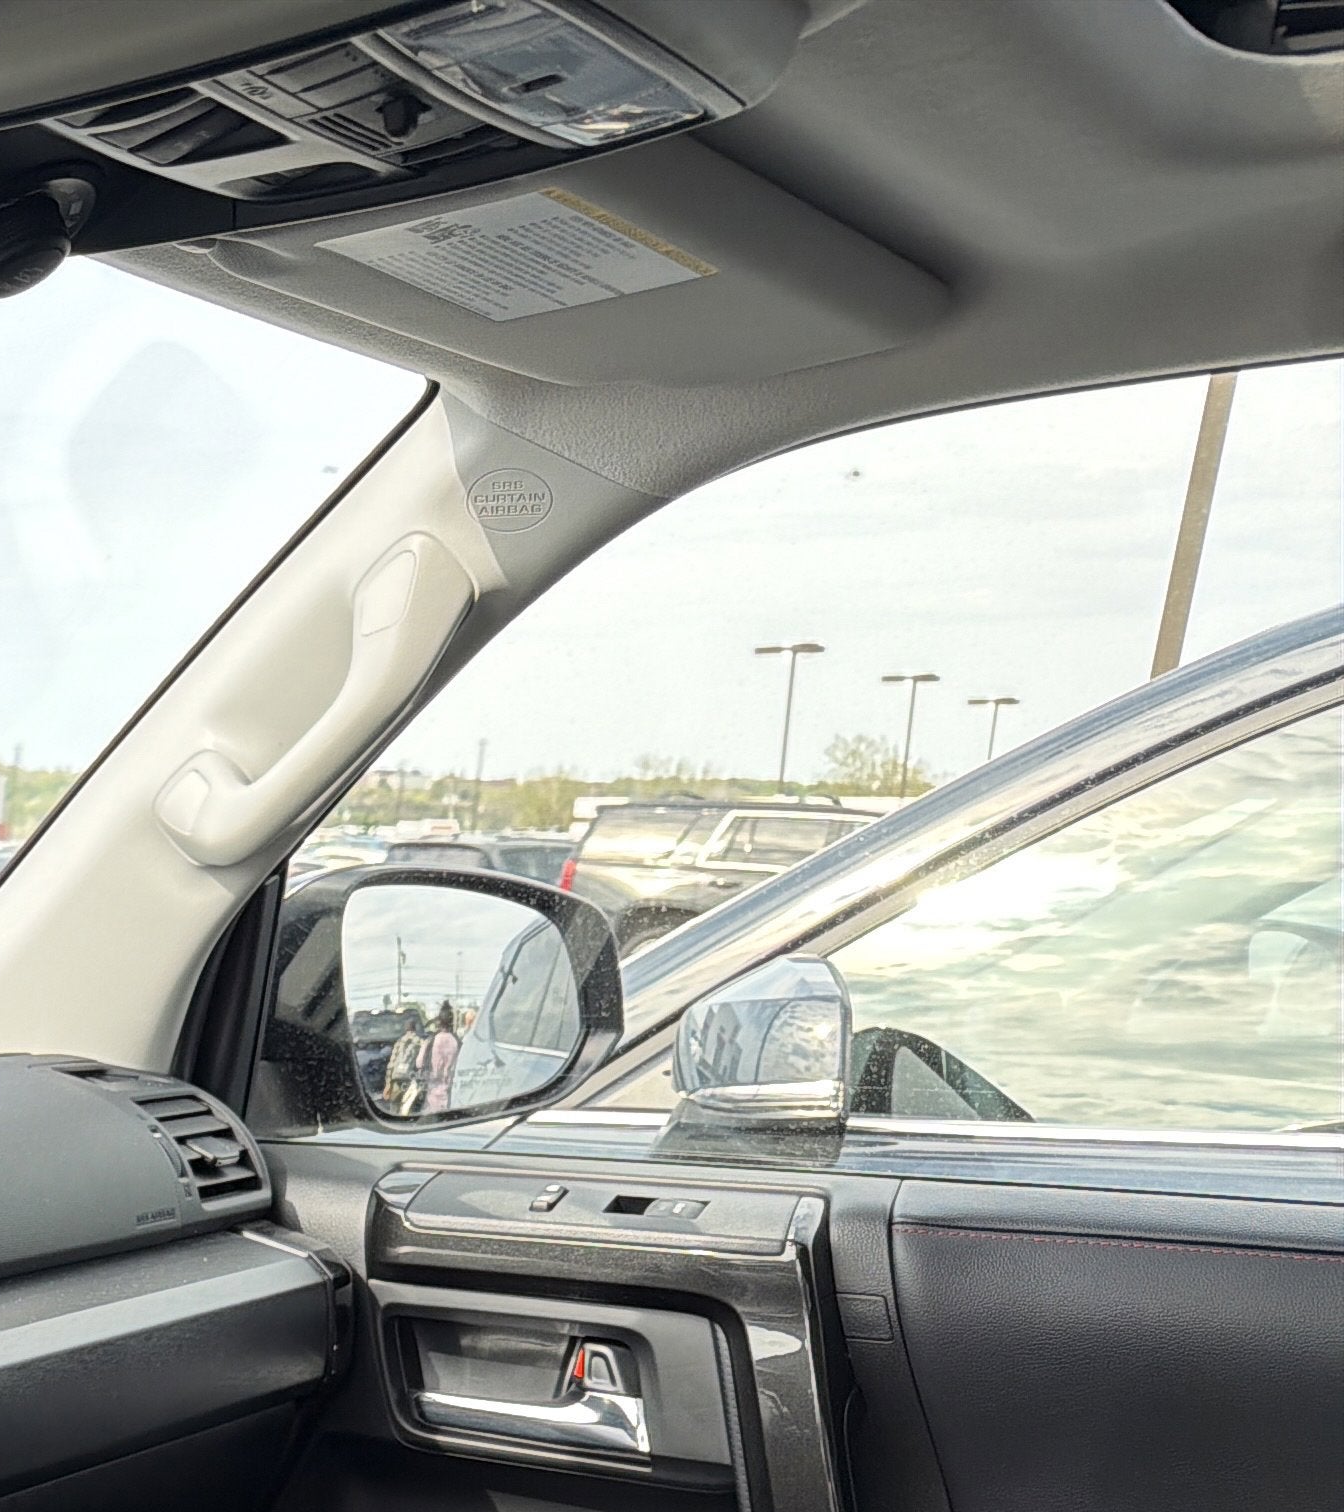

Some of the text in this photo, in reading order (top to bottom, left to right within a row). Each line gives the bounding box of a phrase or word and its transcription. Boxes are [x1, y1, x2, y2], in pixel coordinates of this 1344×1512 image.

[492, 480, 523, 490] SRS
[474, 492, 545, 504] CURTAIN
[478, 503, 542, 515] AIRBAG
